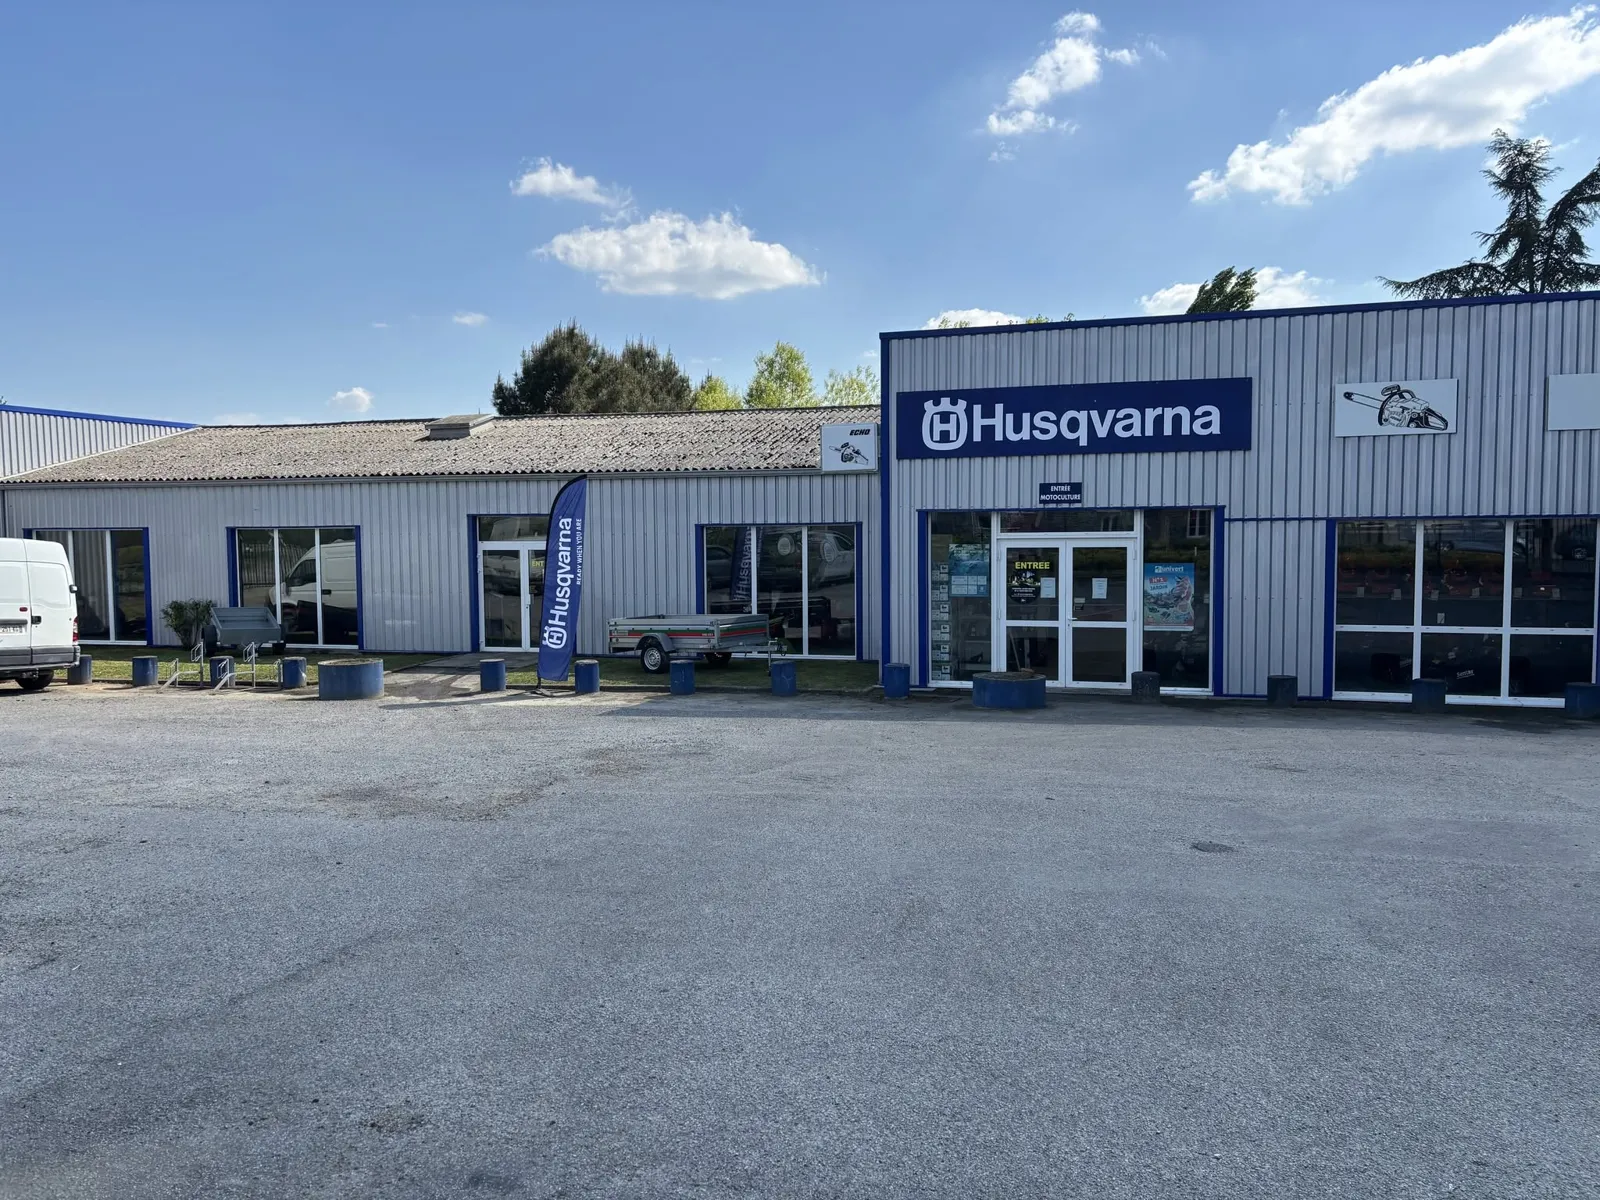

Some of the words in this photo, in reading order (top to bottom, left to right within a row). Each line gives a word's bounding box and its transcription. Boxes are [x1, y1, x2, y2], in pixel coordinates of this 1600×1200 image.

[973, 403, 1221, 447] Husqvarna
[1050, 484, 1071, 492] ENTRÉE
[548, 517, 574, 626] Husqvarna
[1015, 561, 1050, 569] ENTREE
